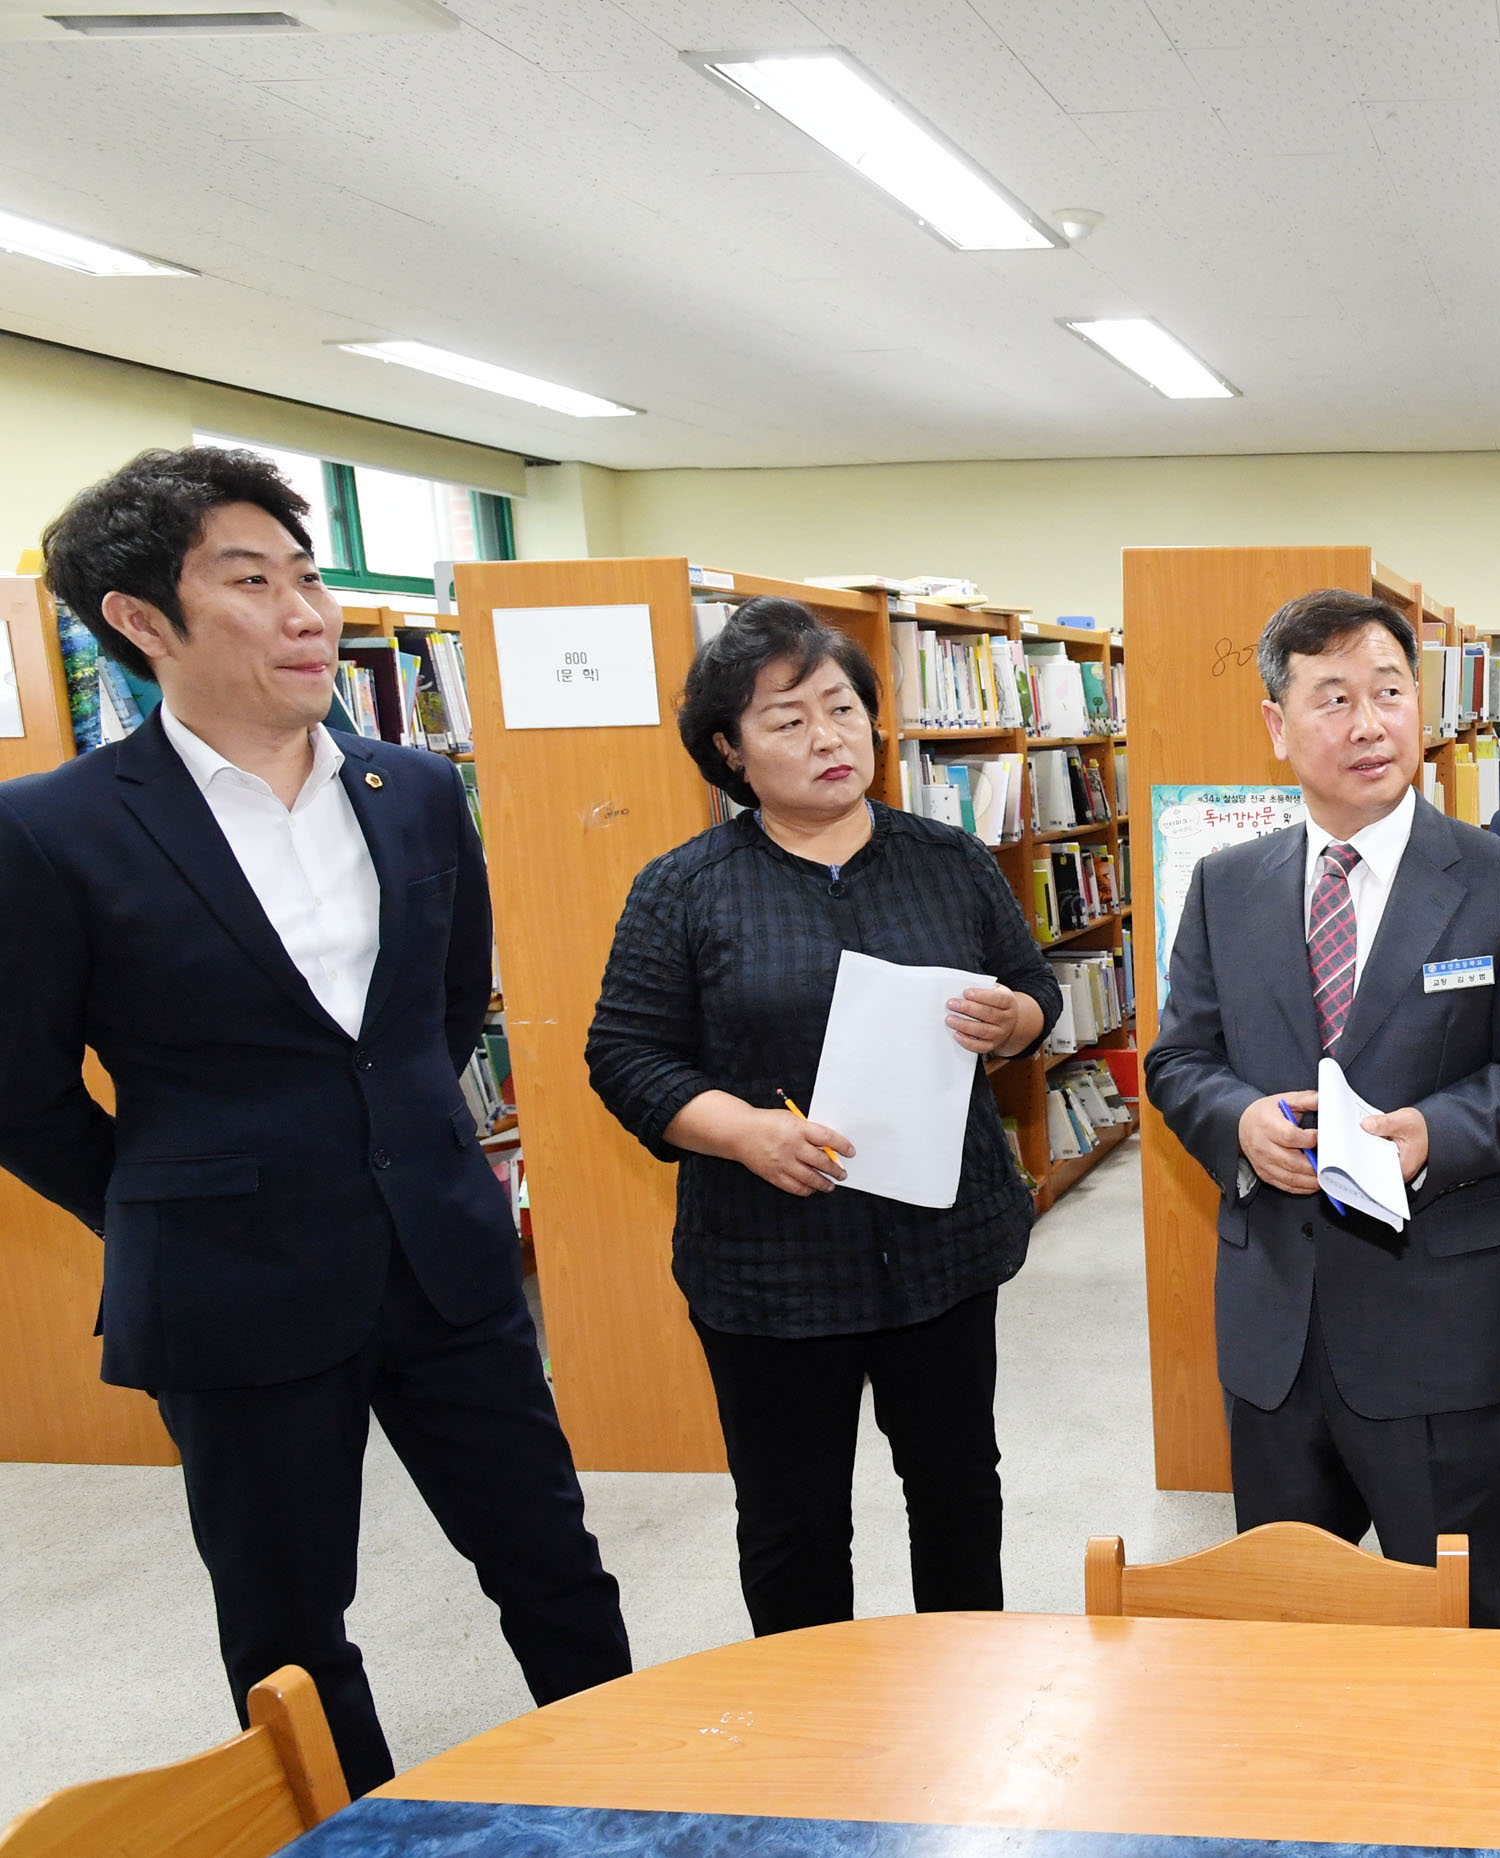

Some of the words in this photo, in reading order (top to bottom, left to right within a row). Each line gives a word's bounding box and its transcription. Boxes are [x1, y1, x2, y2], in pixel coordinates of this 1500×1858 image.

[564, 651, 588, 666] 800
[1211, 637, 1259, 678] 80
[1250, 794, 1266, 804] 전국
[1269, 793, 1301, 804] 초등학생
[1203, 806, 1276, 829] 독서감상문
[1283, 812, 1292, 824] 및
